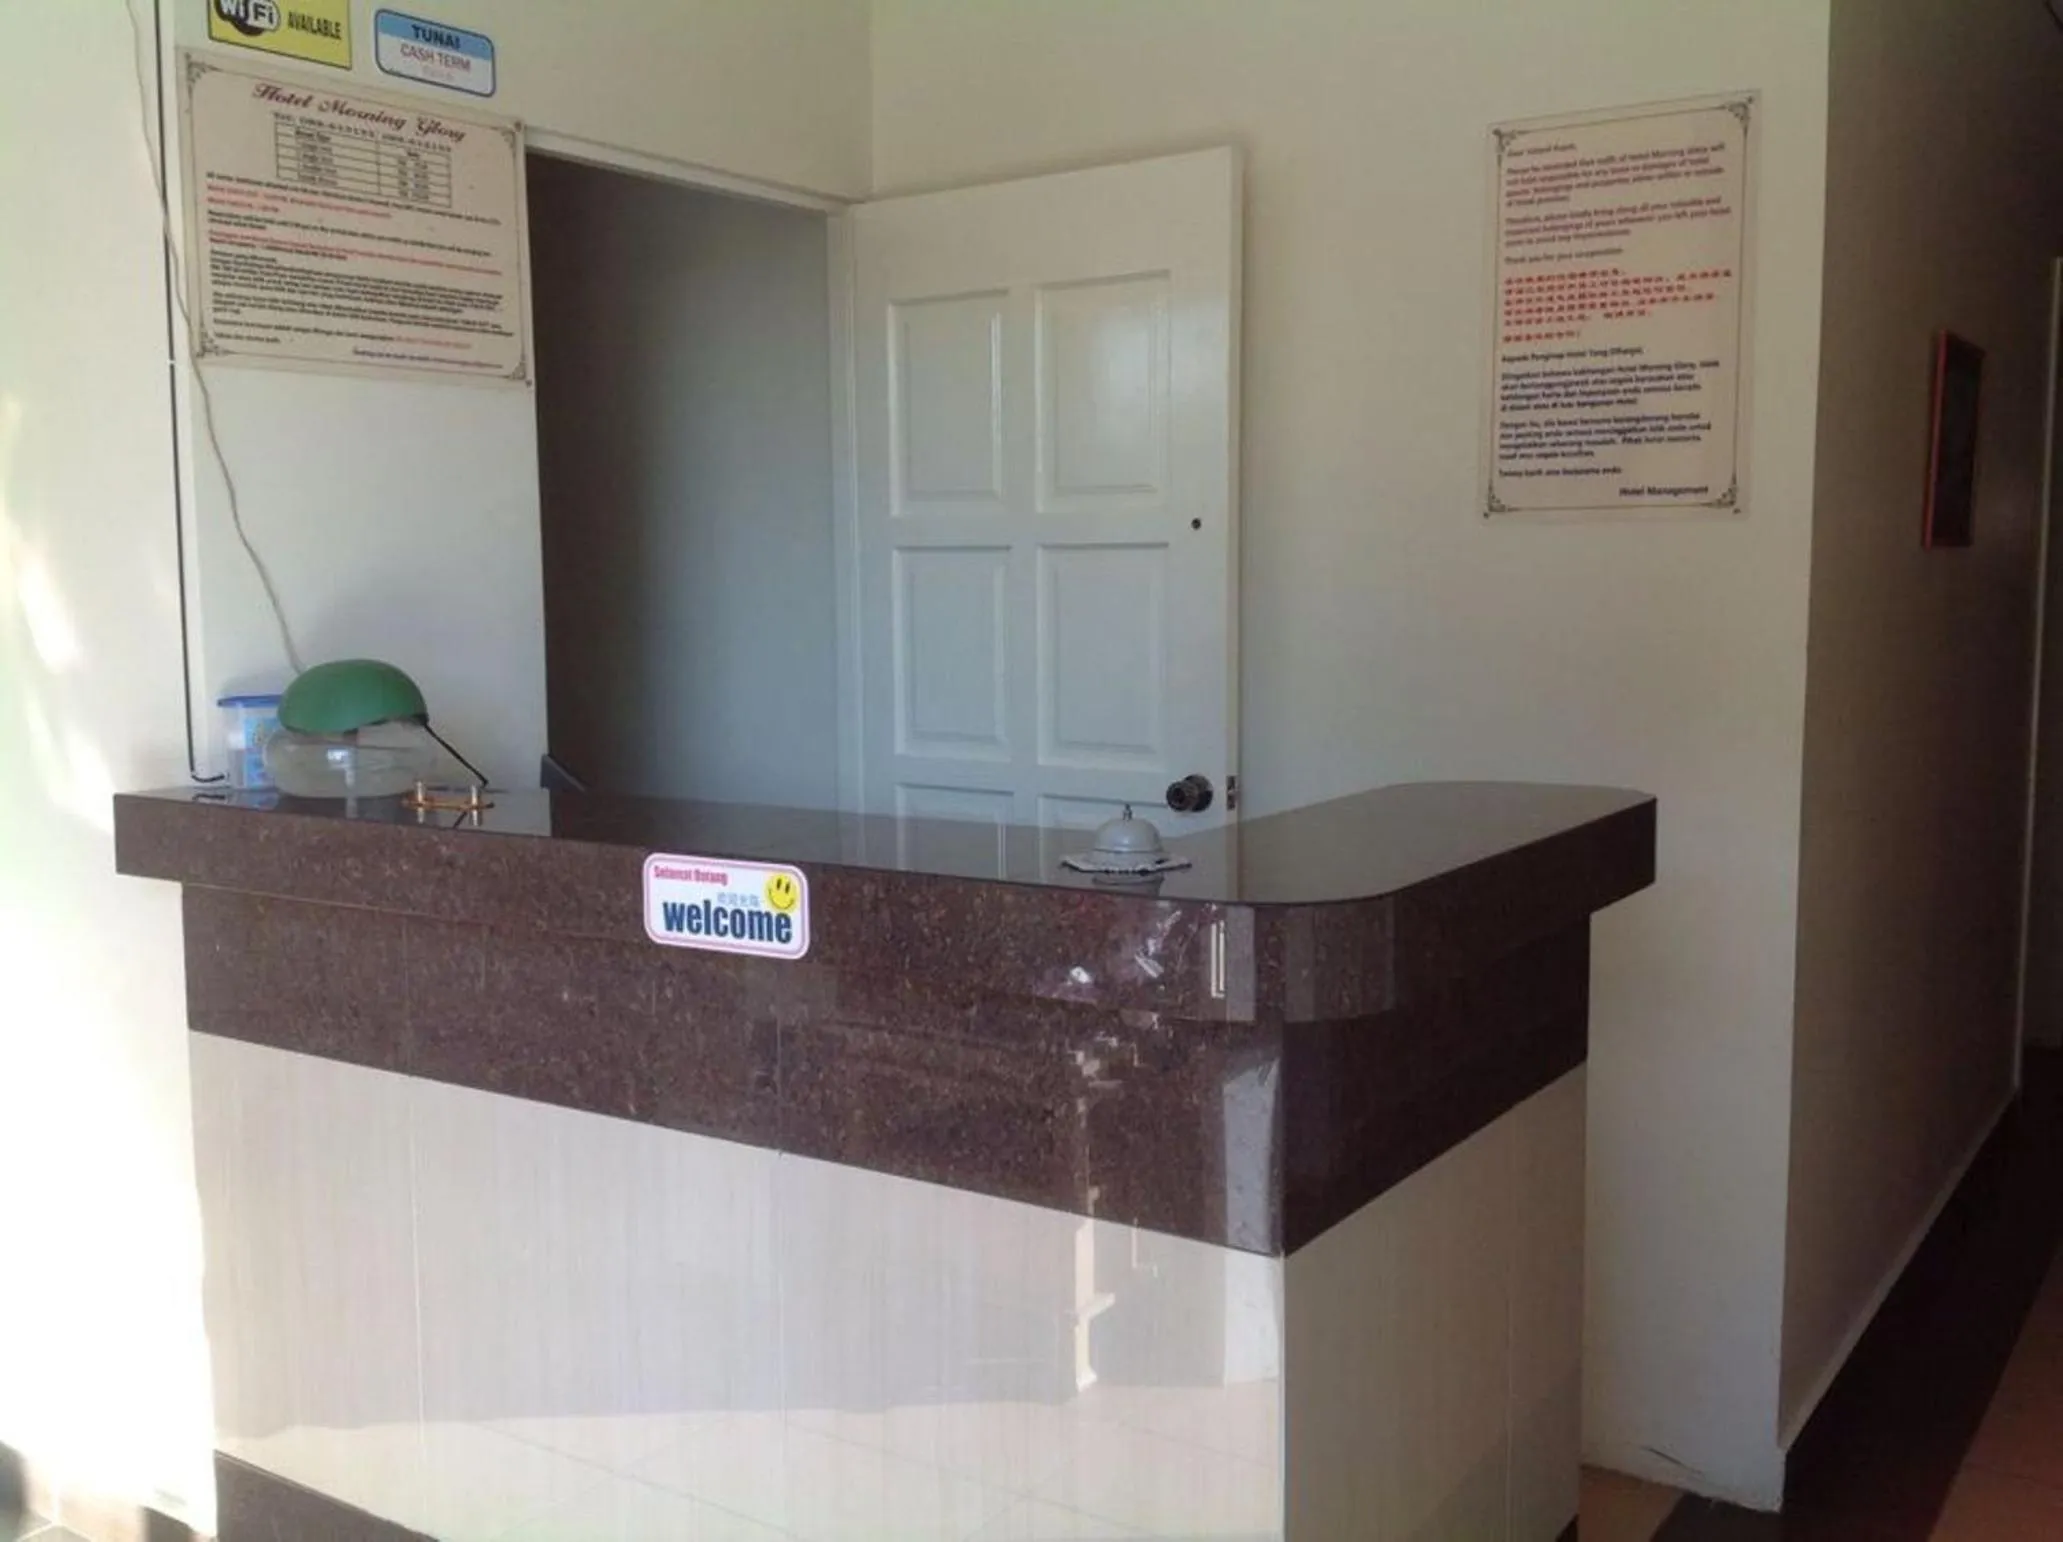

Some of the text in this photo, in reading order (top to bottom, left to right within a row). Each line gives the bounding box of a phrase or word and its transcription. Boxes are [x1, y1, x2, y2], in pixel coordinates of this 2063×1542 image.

[287, 11, 342, 40] AVAILABLE
[411, 23, 461, 49] TUNAI
[400, 43, 435, 62] CASH
[252, 83, 314, 108] Hotel
[318, 101, 407, 131] Morning
[416, 117, 466, 142] Glory
[663, 899, 792, 943] welcome
